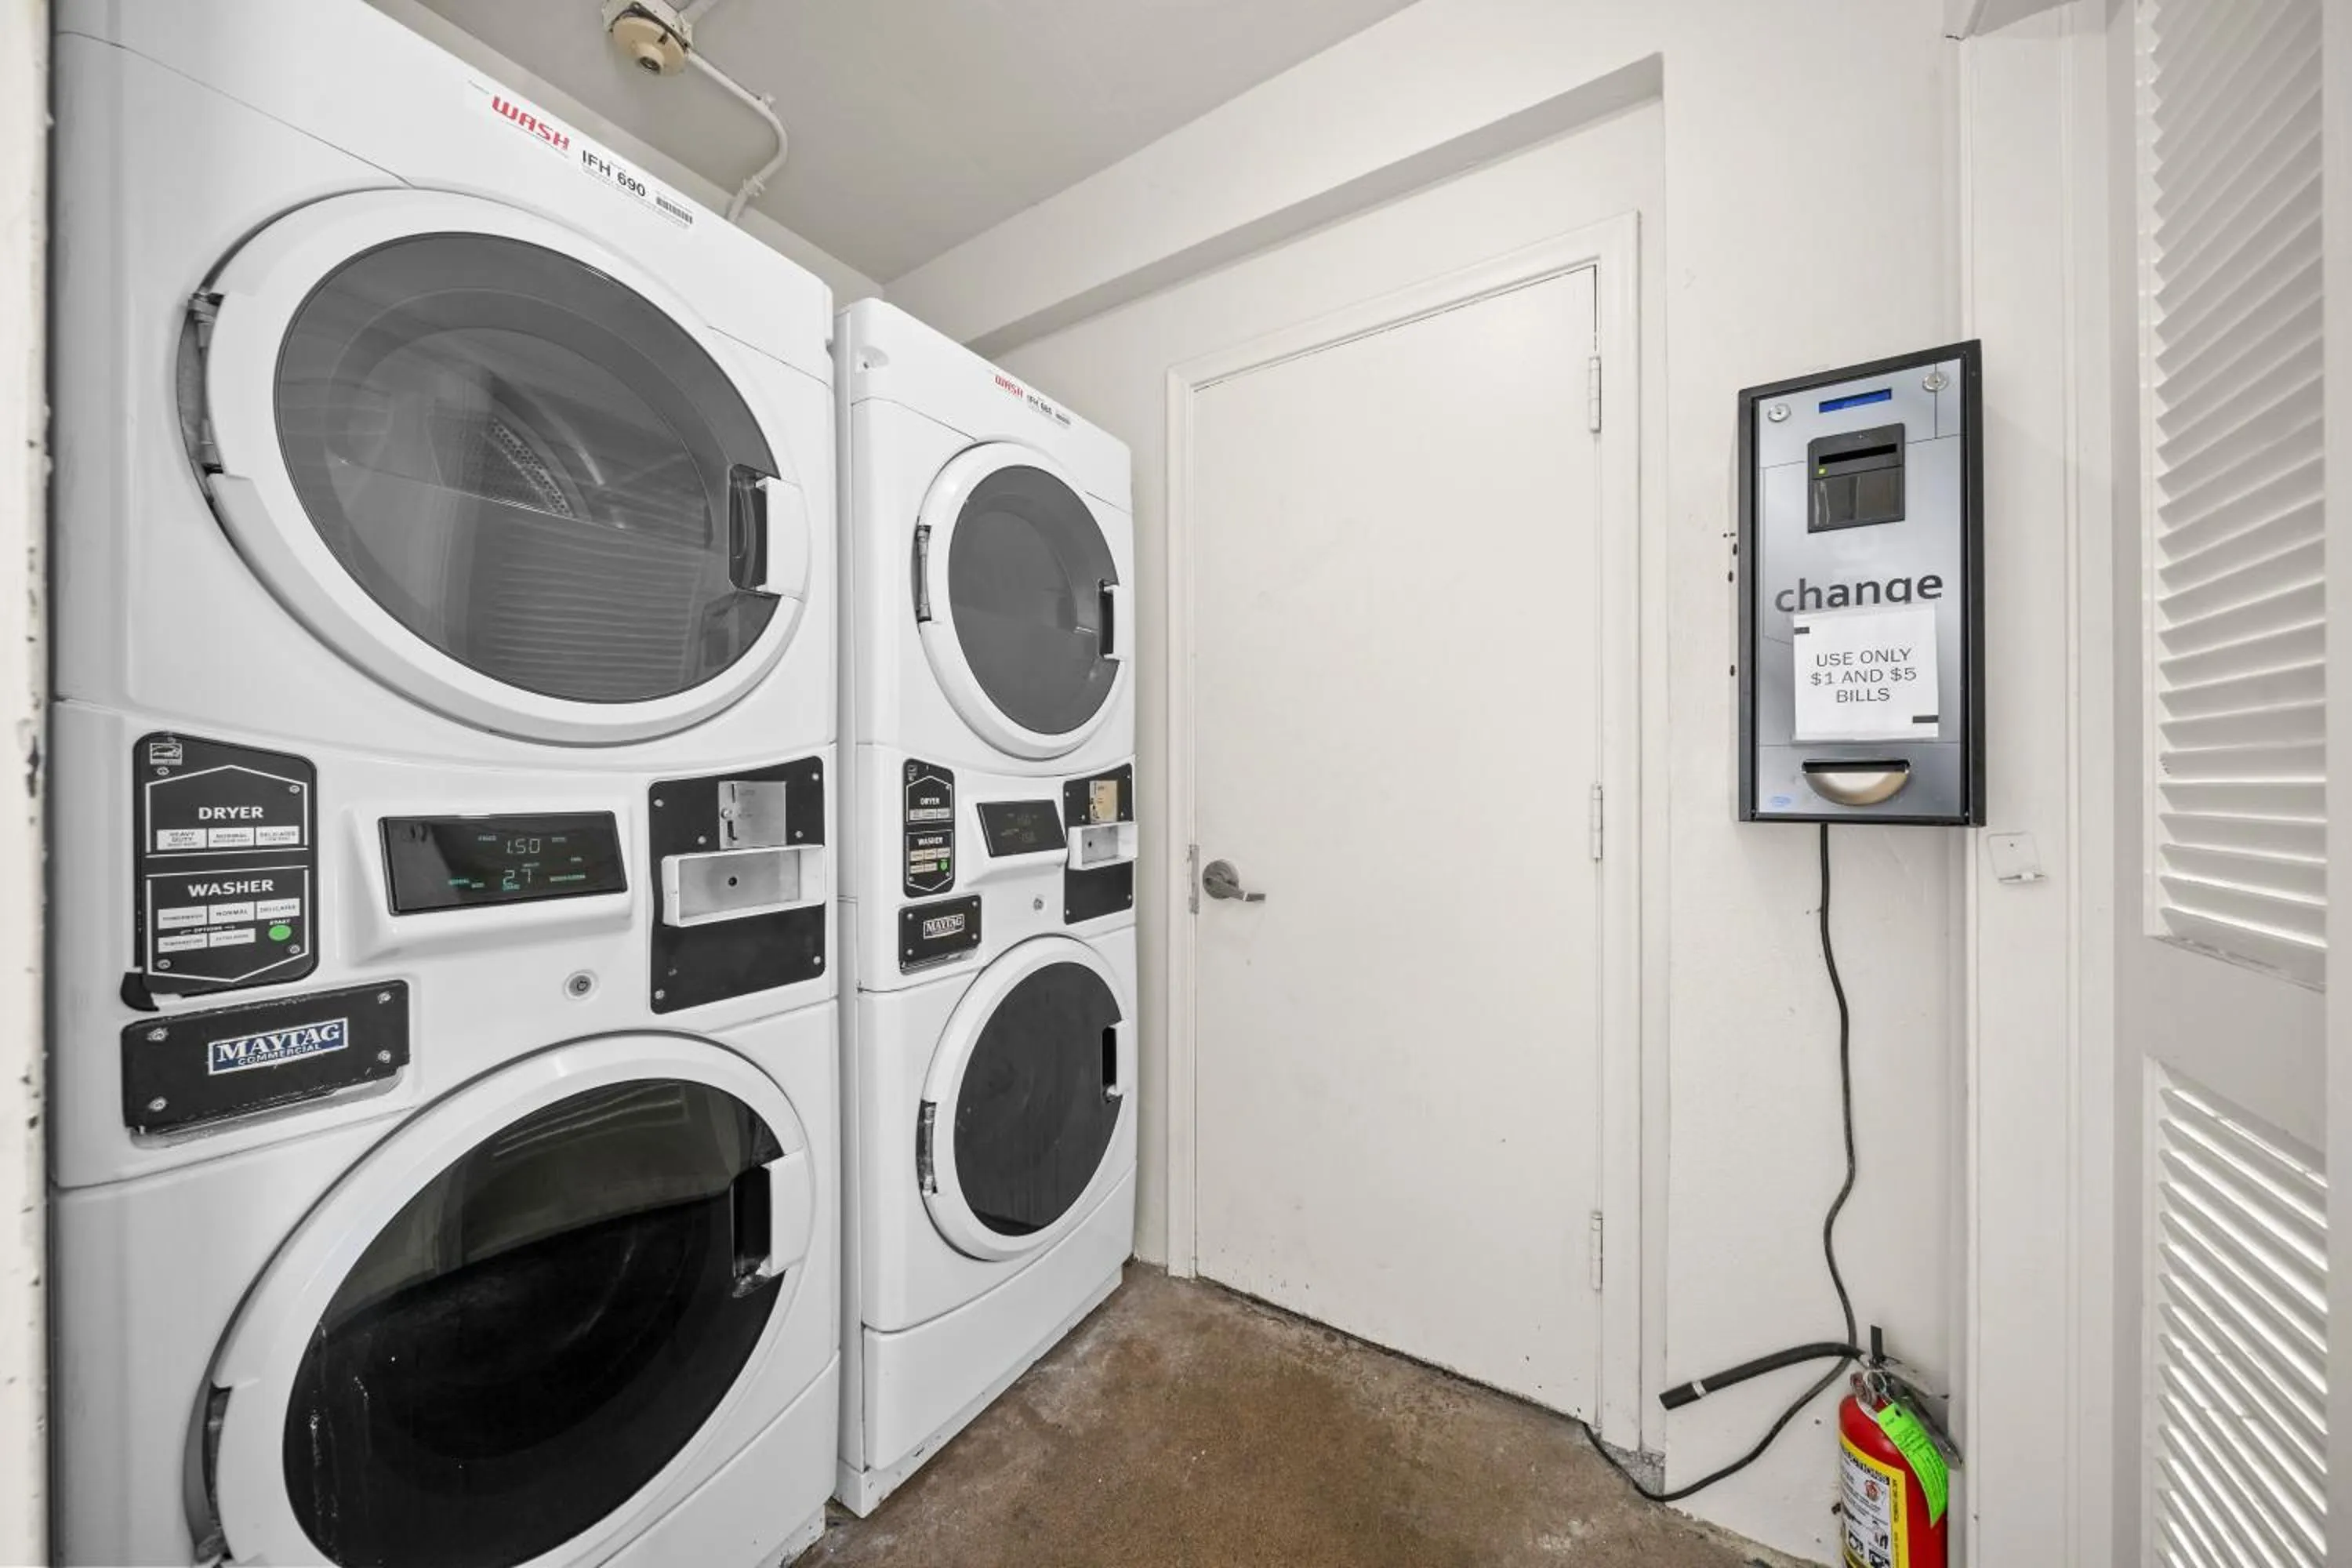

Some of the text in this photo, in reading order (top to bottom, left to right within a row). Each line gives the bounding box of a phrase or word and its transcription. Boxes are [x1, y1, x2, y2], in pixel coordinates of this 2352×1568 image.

[492, 96, 647, 197] WASH IFH 690
[1816, 648, 1912, 667] USE ONLY
[1810, 667, 1917, 686] $1 AND $5
[1836, 688, 1890, 703] BILLS
[198, 806, 264, 820] DRYER
[187, 879, 274, 897] WASHER
[216, 1022, 340, 1062] MAYTAG
[238, 1043, 321, 1066] COMMERCIAL
